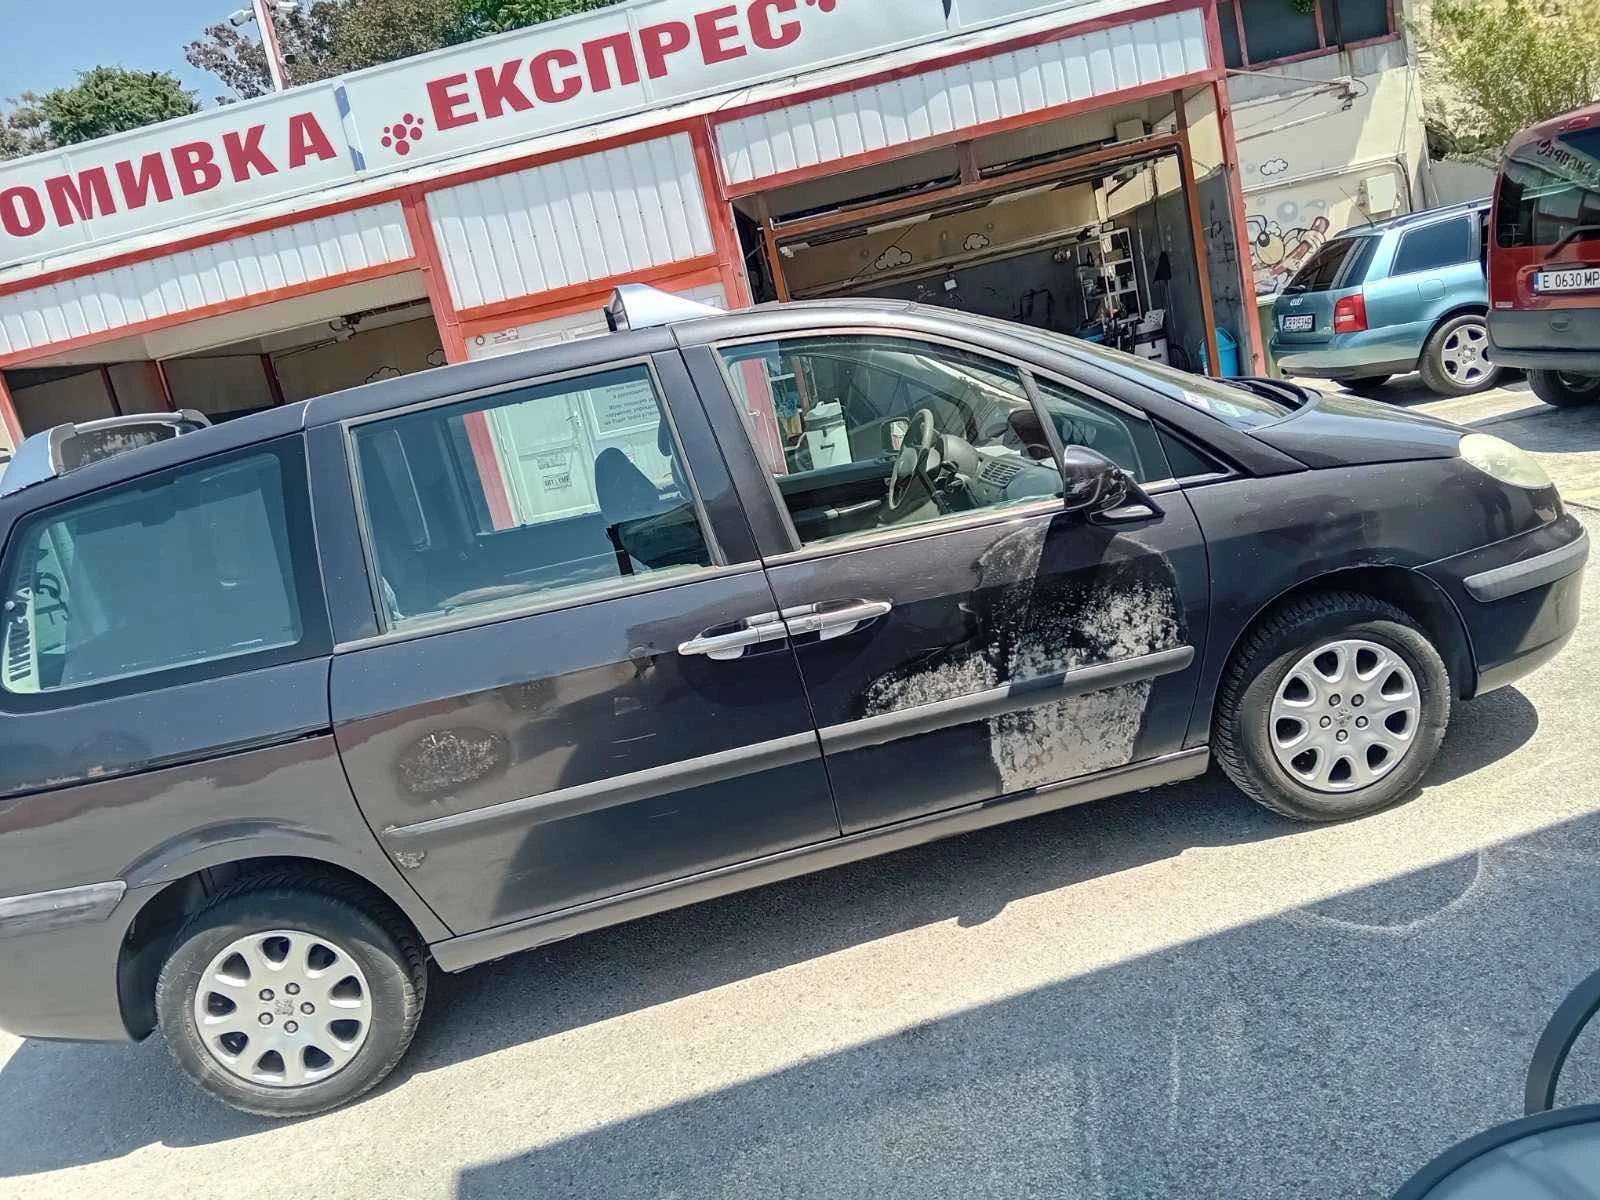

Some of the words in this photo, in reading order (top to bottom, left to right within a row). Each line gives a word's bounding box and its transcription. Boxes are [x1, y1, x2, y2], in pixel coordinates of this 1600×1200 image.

[0, 111, 337, 237] ОМИВКА
[426, 0, 802, 131] ЕКСПРЕС
[1543, 274, 1550, 289] E
[1555, 272, 1583, 288] 0630
[1584, 271, 1600, 287] MP
